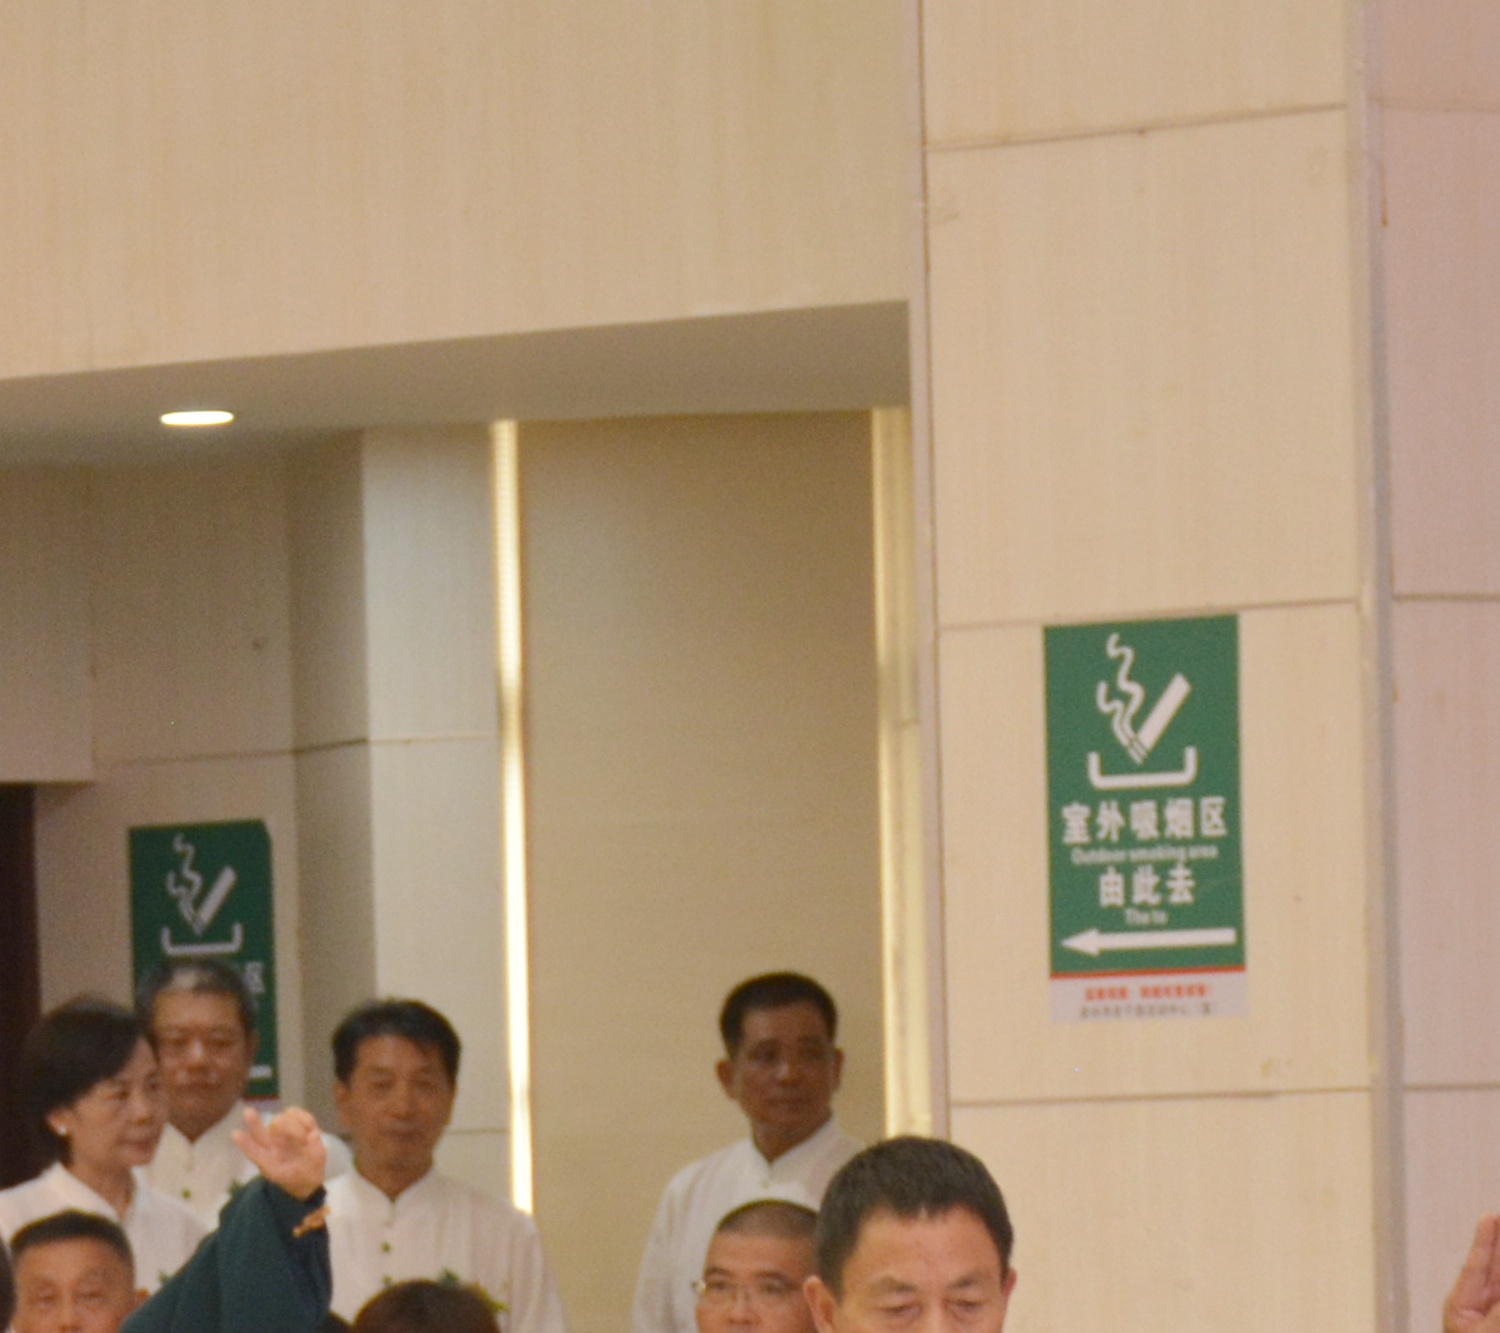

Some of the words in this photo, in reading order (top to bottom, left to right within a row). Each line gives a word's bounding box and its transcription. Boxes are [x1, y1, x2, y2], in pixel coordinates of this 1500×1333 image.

[1061, 796, 1227, 844] 室外吸烟区
[1099, 865, 1195, 907] 由此去
